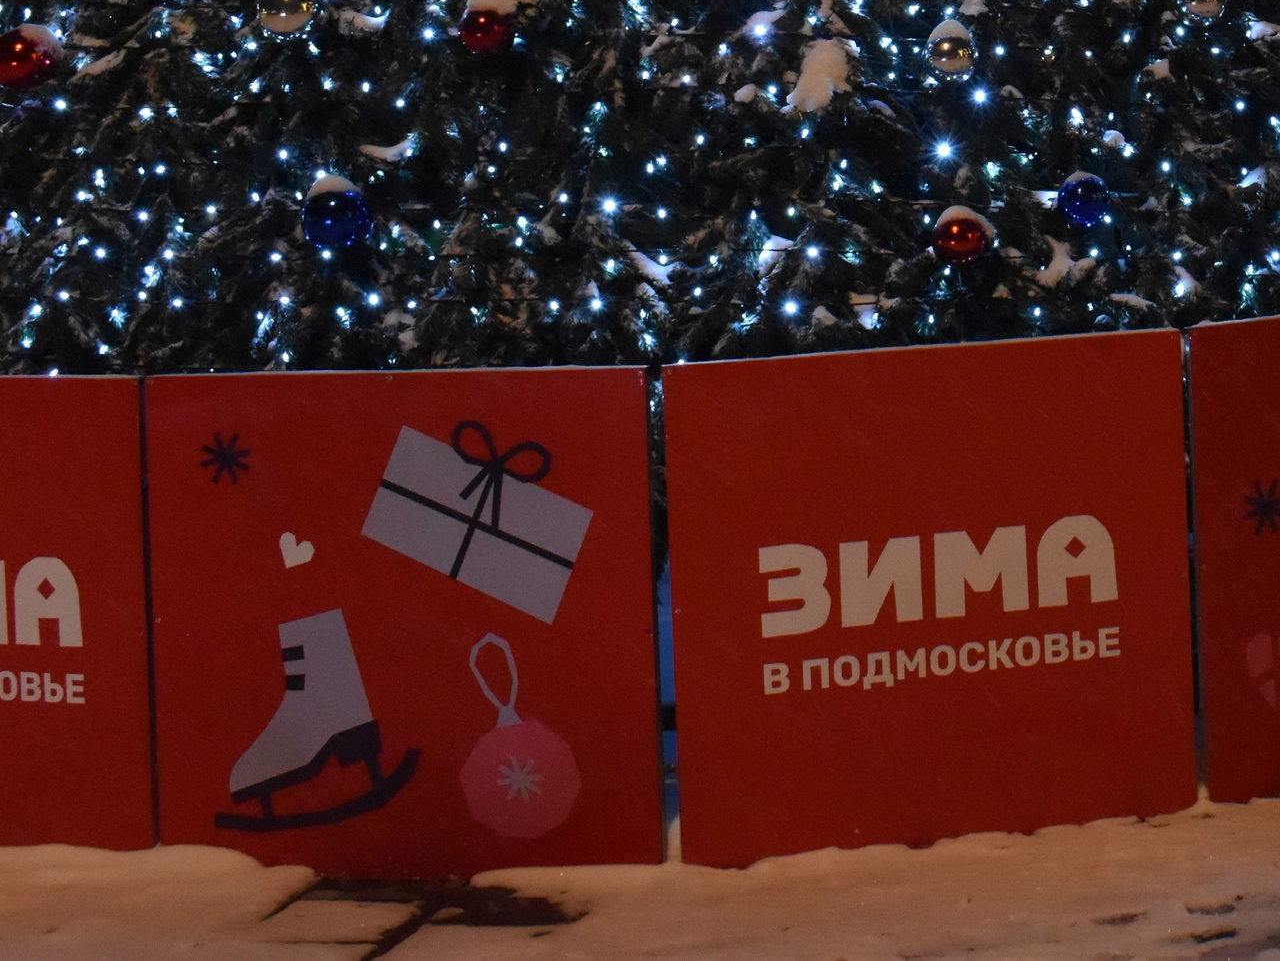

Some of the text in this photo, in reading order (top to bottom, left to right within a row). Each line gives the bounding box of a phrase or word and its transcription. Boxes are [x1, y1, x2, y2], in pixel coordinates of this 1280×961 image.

[758, 514, 1118, 638] ЗИМА
[0, 670, 86, 704] ОВЬЕ
[763, 626, 1121, 695] В ПОДМОСКОВЬЕ
